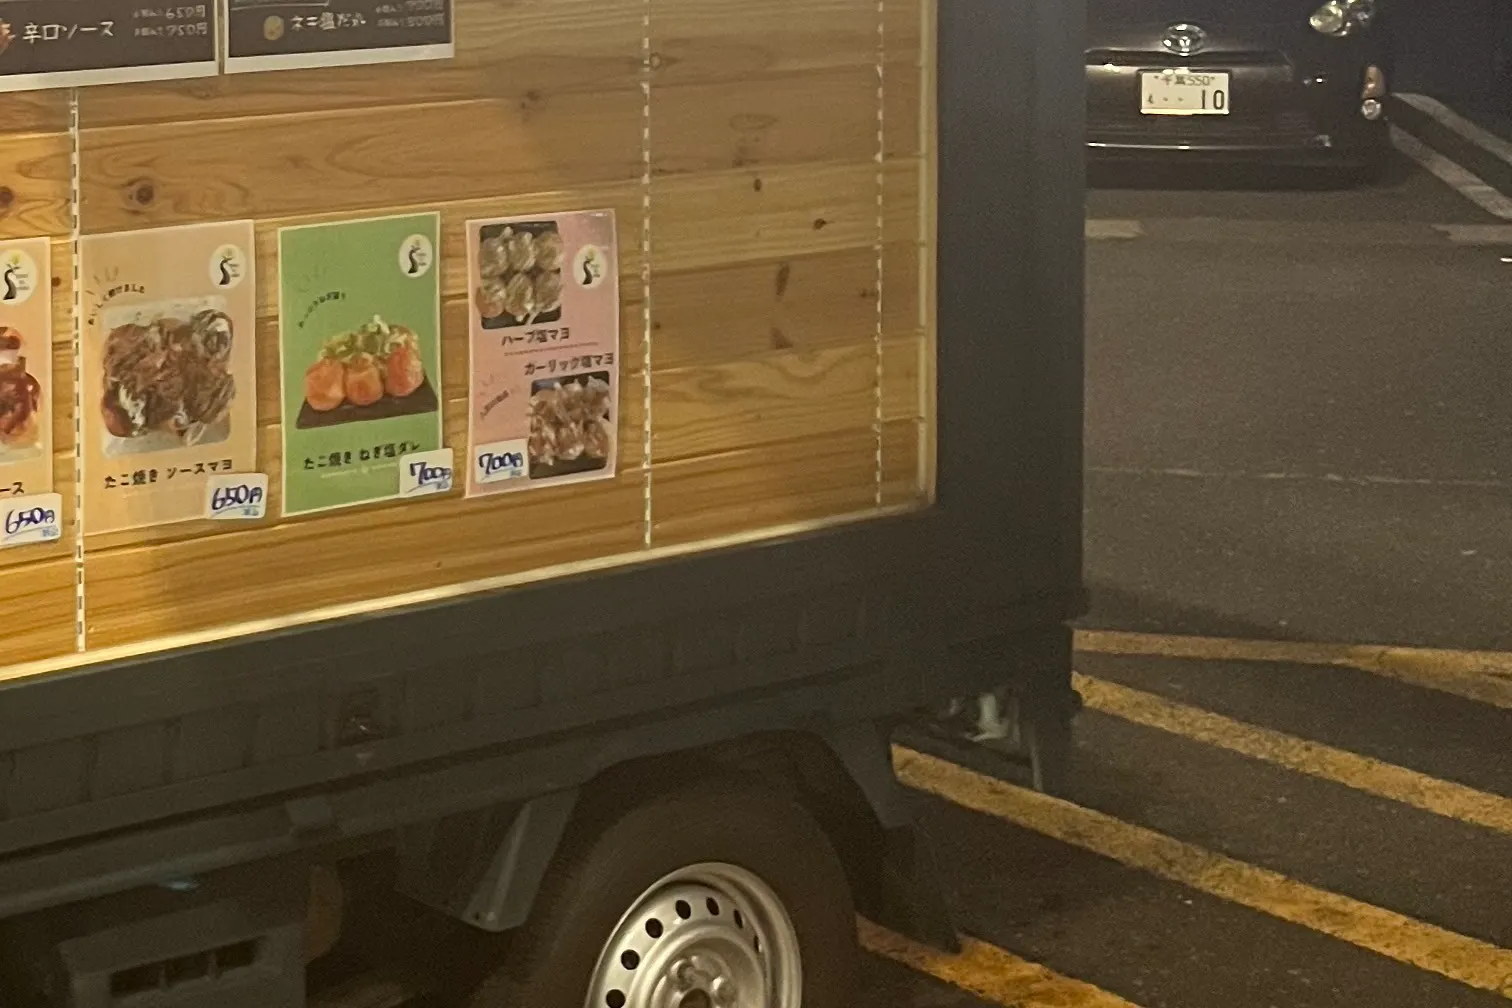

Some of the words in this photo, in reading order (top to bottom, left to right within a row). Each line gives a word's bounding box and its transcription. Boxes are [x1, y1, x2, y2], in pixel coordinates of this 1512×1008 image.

[22, 21, 115, 44] 辛口ソース
[524, 352, 614, 376] ガーリック塩マヨ
[303, 451, 352, 471] たこ焼き
[104, 469, 159, 489] たこ焼き
[166, 459, 233, 479] ソースマヨ
